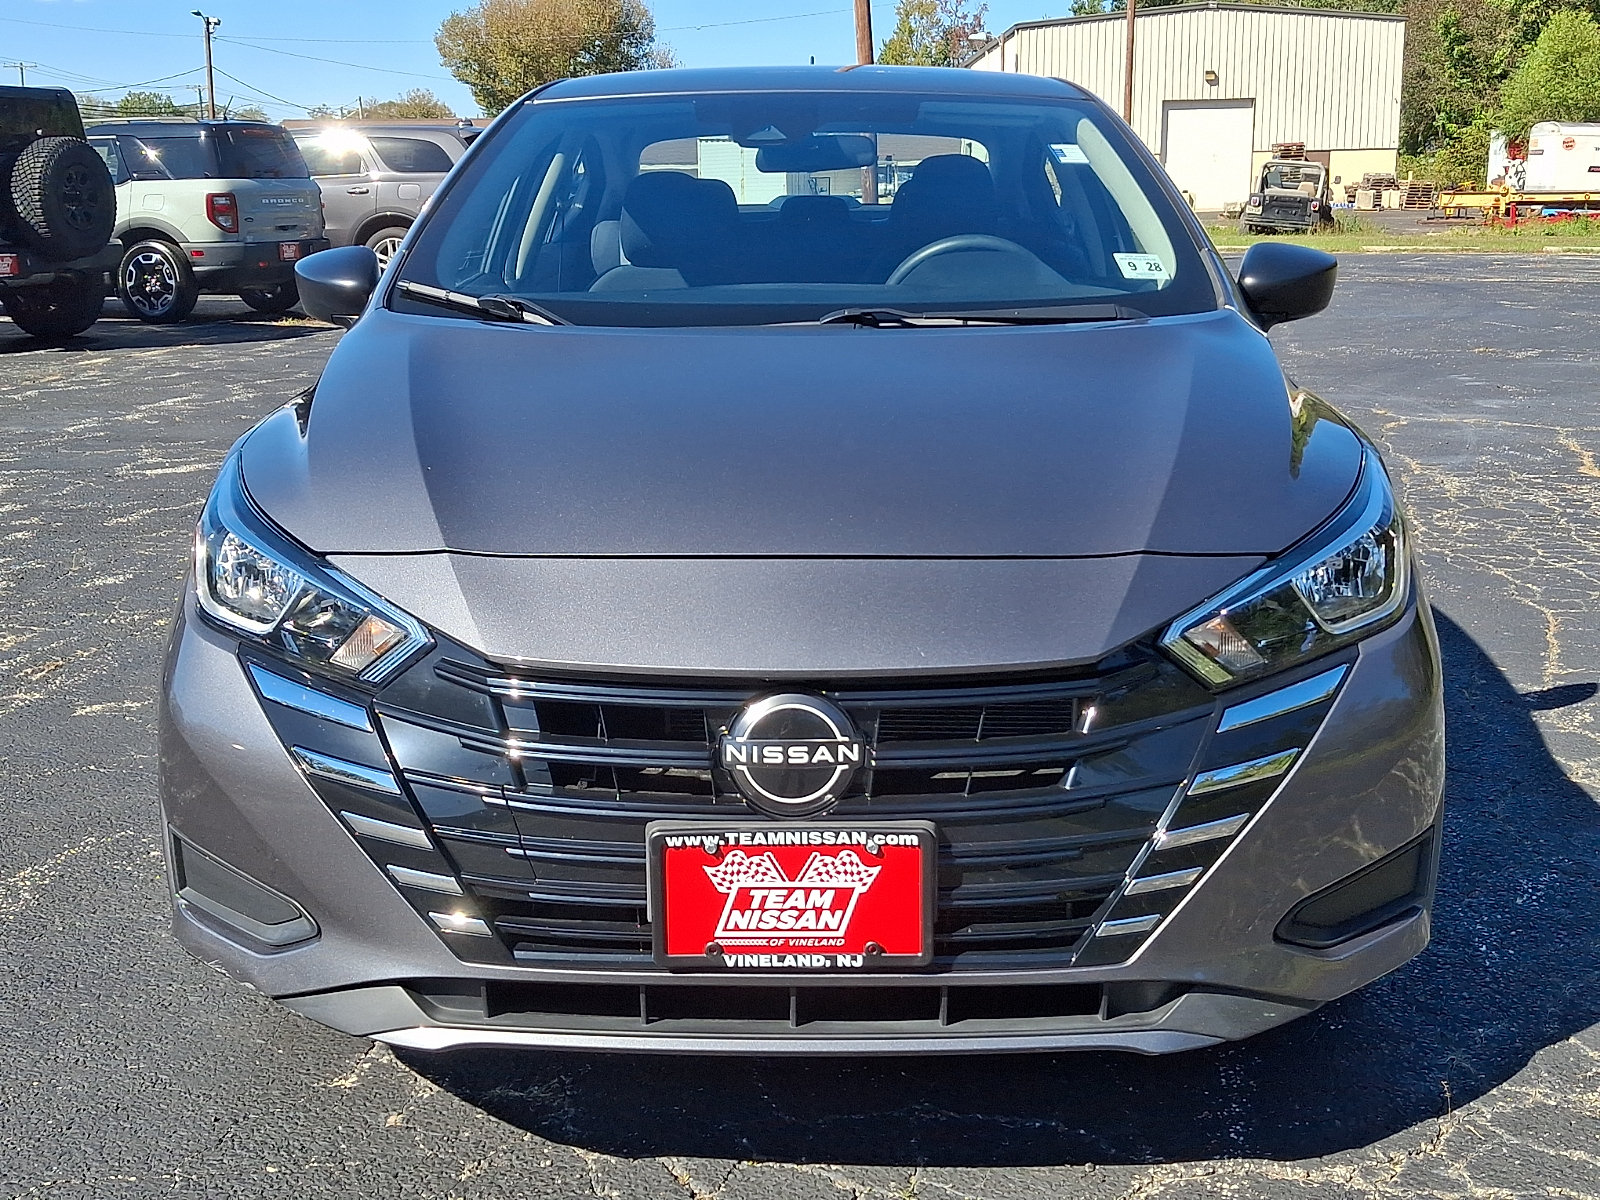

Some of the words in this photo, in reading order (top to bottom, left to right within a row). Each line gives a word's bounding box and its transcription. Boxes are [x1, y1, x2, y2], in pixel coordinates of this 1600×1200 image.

[1127, 261, 1138, 271] 9
[1145, 261, 1163, 272] 28
[725, 743, 859, 764] NISSAN
[665, 831, 919, 847] www.TEAMNISSAN.com
[749, 889, 836, 909] TEAM
[726, 909, 844, 930] NISSAN
[768, 938, 783, 947] OF
[788, 938, 845, 947] VINELAND
[722, 954, 832, 968] VINELAND,
[836, 954, 864, 968] NJ
